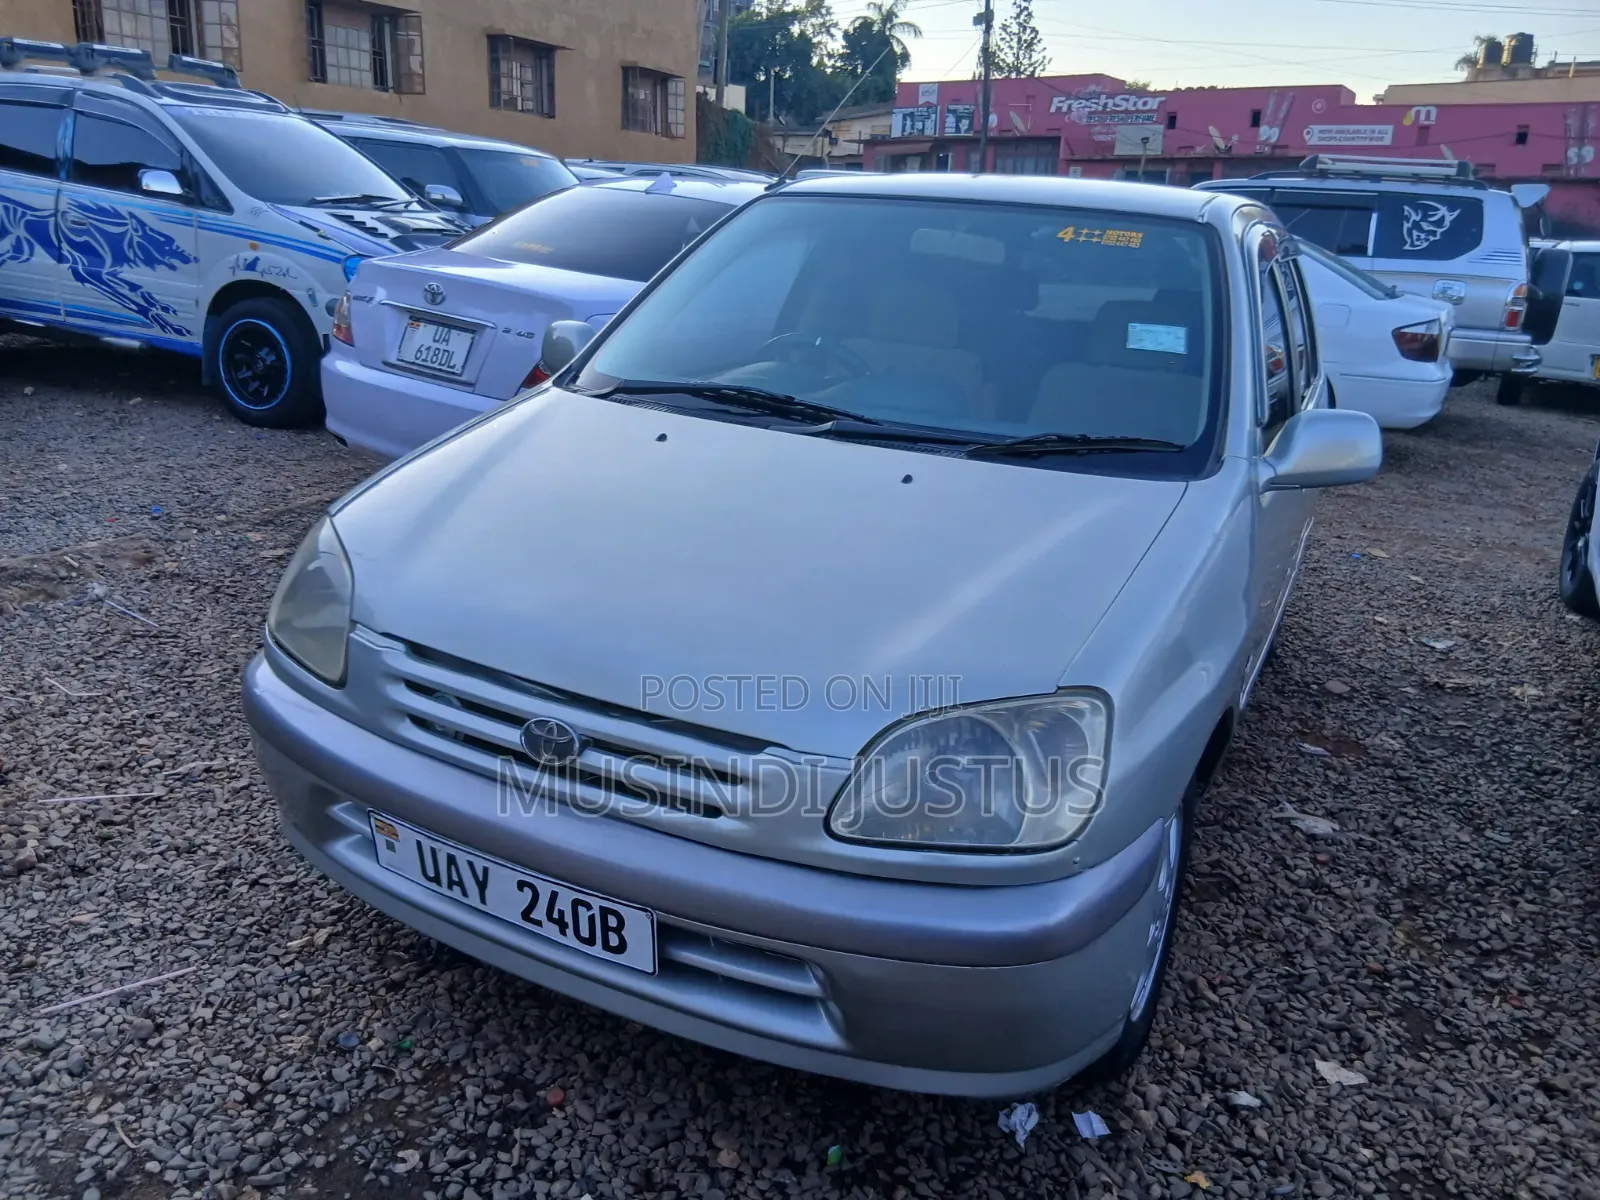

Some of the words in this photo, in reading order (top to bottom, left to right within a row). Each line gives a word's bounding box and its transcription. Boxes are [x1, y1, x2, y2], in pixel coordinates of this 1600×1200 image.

[1049, 95, 1166, 113] FreshStar
[1056, 226, 1076, 242] 4
[1106, 230, 1144, 238] MOTORS
[432, 326, 452, 346] UA
[414, 343, 457, 370] 618DL
[415, 839, 490, 906] UAY
[516, 879, 629, 956] 240B
